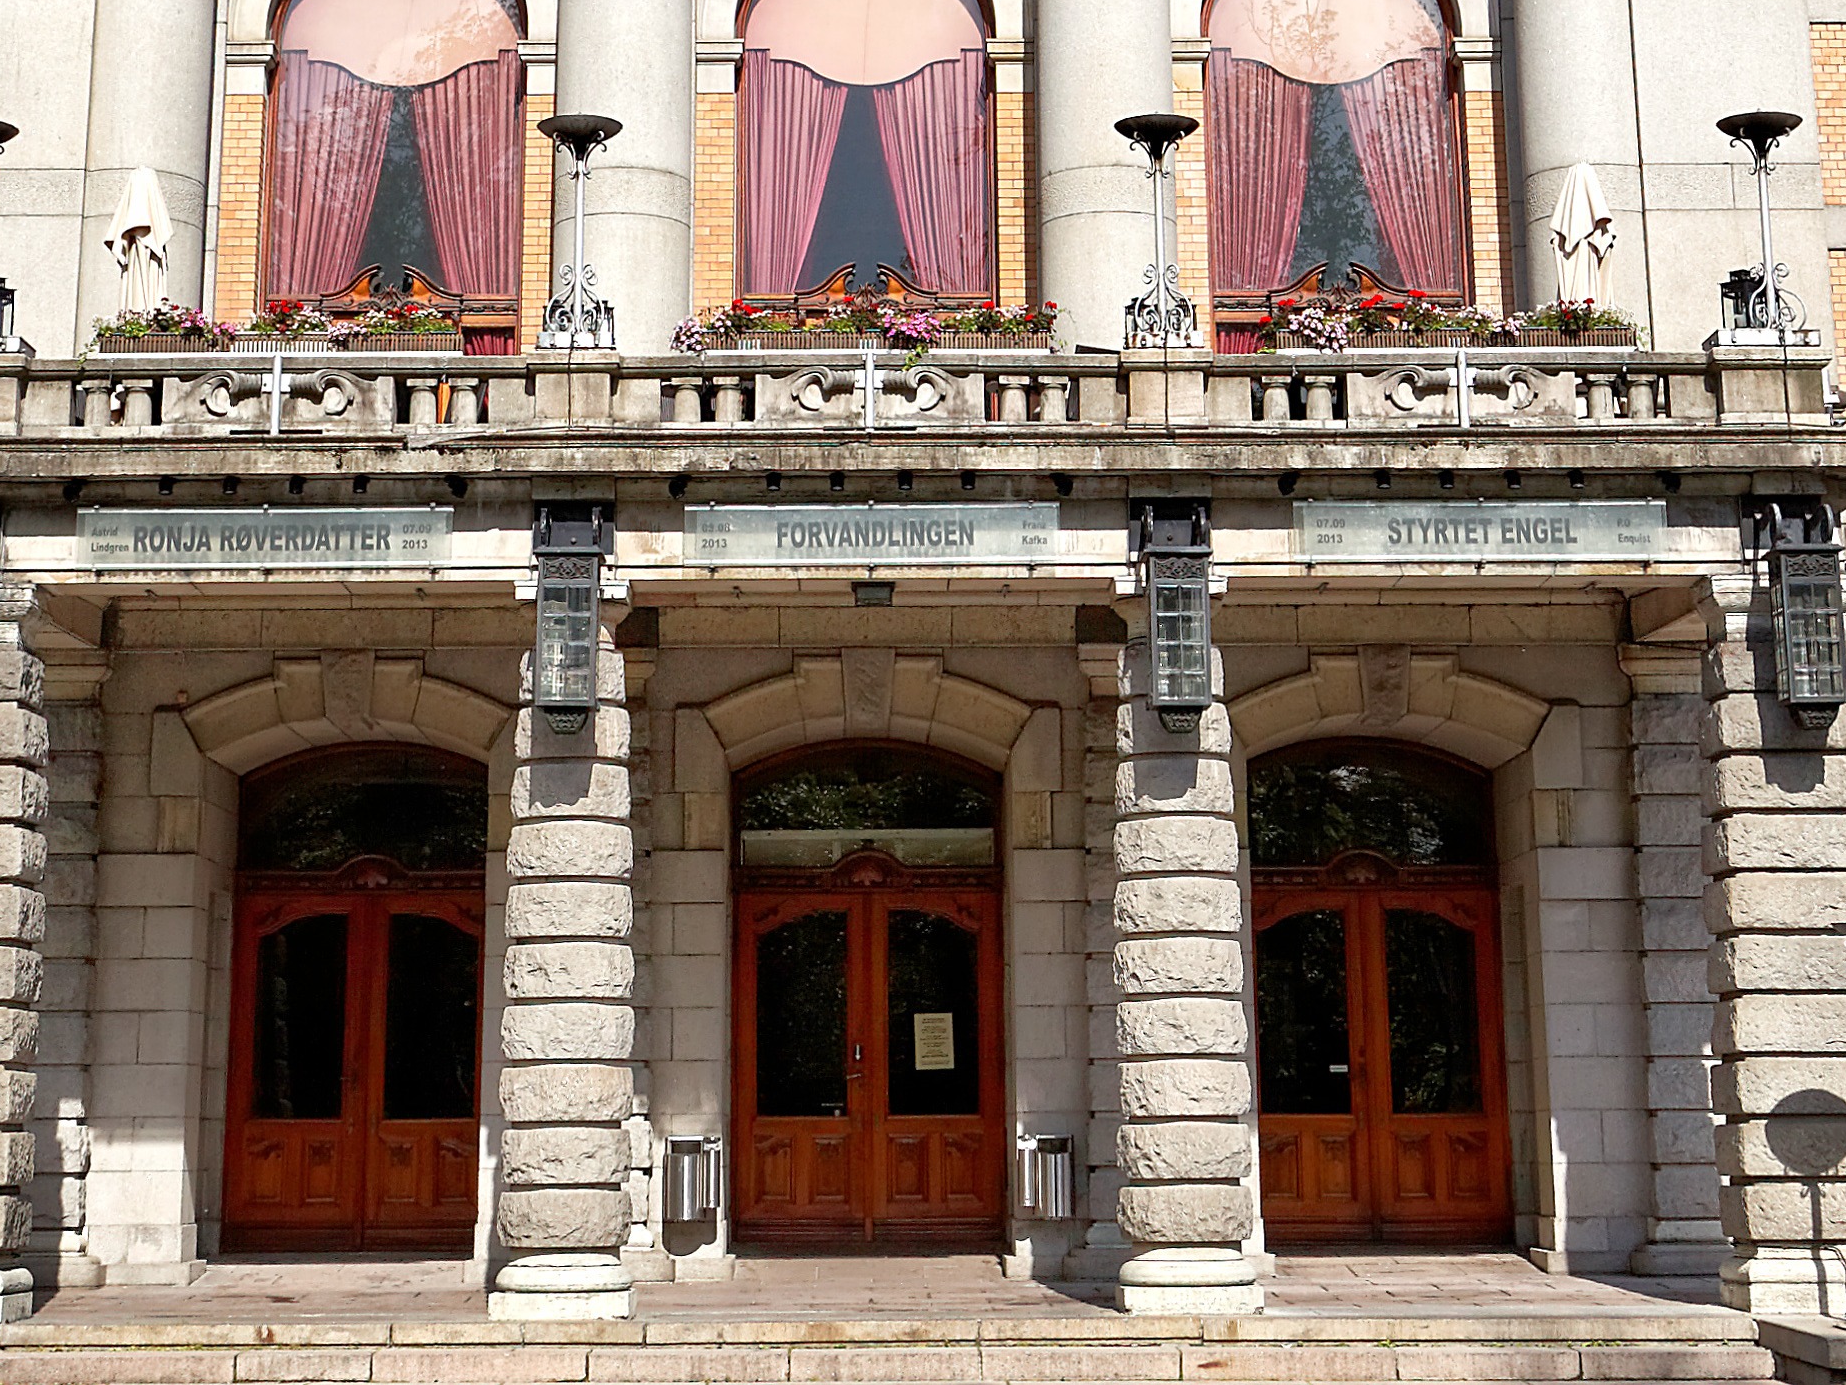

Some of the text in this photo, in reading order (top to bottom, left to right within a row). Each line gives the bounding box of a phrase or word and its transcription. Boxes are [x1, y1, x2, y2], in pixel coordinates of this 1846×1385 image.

[402, 523, 432, 534] 07.09
[1022, 520, 1047, 530] Franz
[1316, 518, 1346, 529] 07.09
[91, 526, 119, 537] Astrid
[776, 520, 974, 549] FORVANDLINGEN
[1387, 517, 1578, 546] STYRTET ENGEL
[133, 524, 391, 553] RONJA RØVERDATTER
[702, 538, 728, 549] 2013
[1021, 535, 1048, 546] Kafka
[1316, 533, 1343, 544] 2013
[1617, 532, 1652, 544] Enquist
[91, 542, 129, 554] Lindgren
[402, 539, 428, 550] 2013
